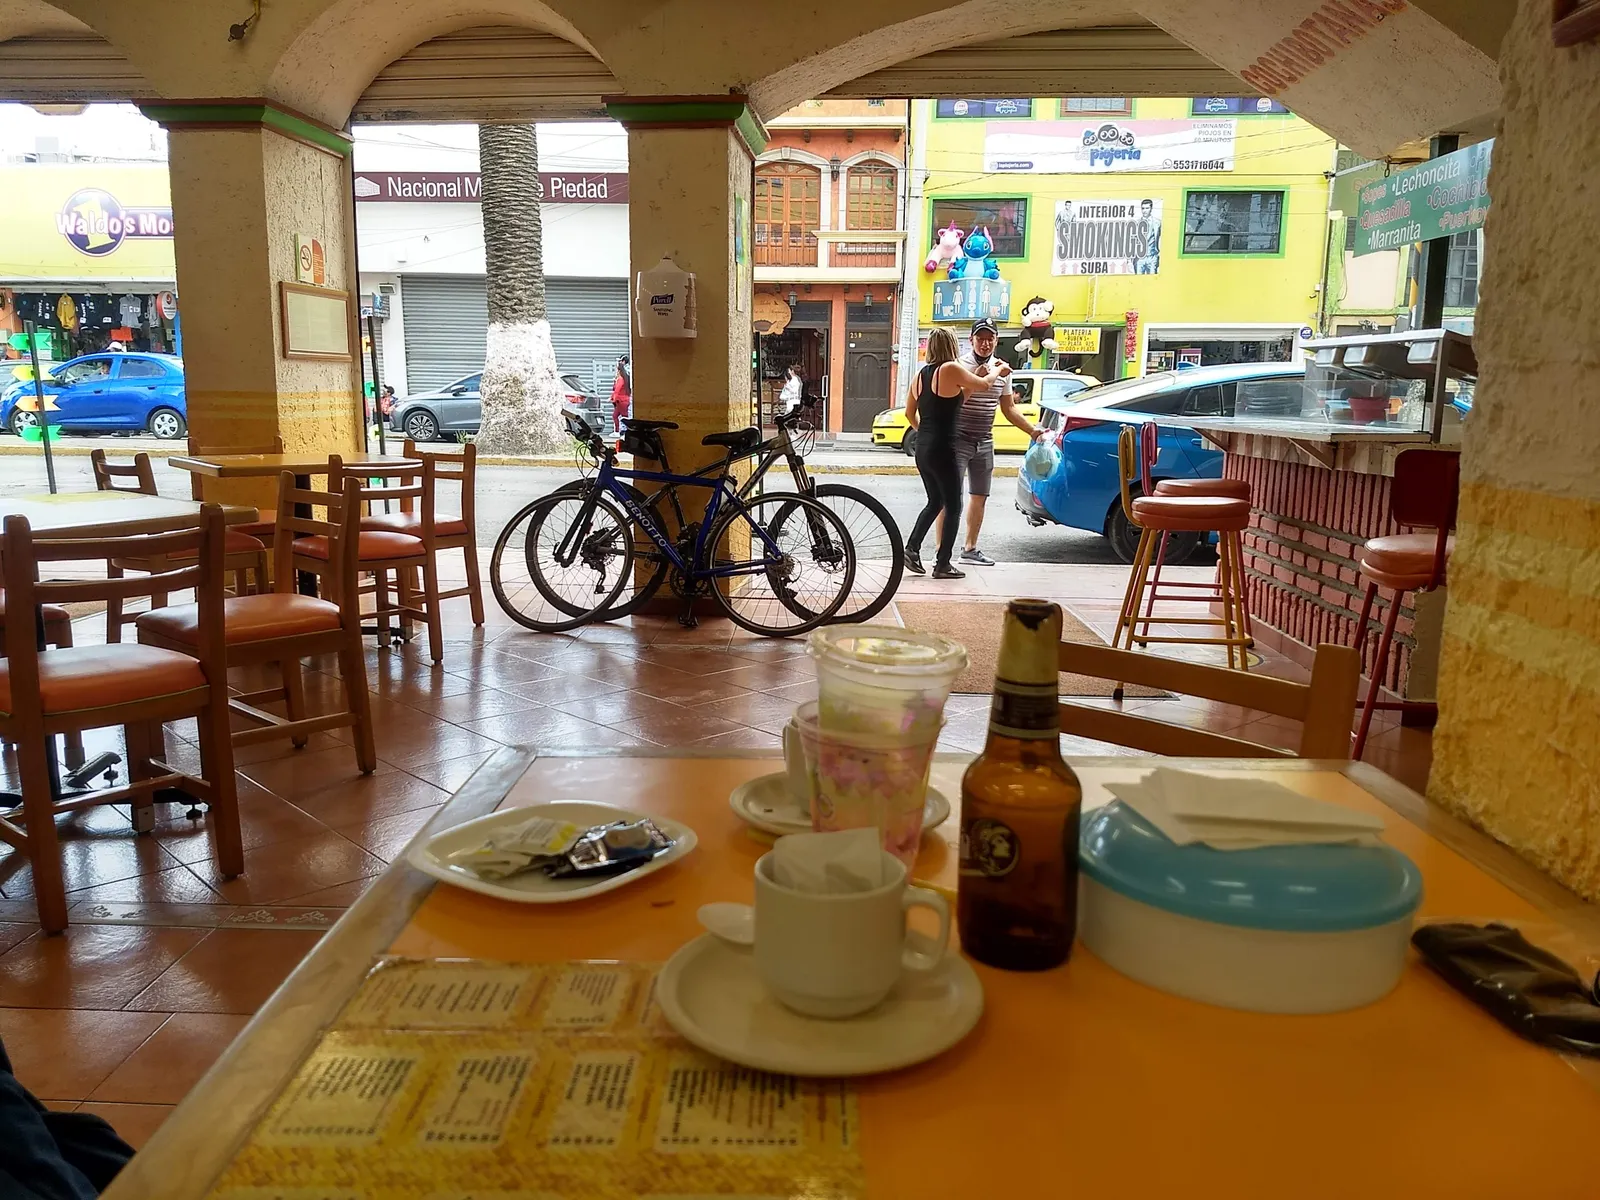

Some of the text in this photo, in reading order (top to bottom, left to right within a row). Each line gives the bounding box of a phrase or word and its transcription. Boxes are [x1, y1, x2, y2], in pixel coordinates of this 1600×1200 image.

[1173, 159, 1225, 170] 5531716044
[1396, 157, 1461, 196] Lechoncita
[387, 177, 462, 198] Nacional
[551, 177, 608, 198] Piedad
[55, 210, 135, 236] Waldo's
[1079, 205, 1135, 218] INTERIOR 4
[1362, 197, 1411, 231] Quesadilla
[1058, 220, 1149, 260] SMOKINGS
[1370, 220, 1421, 250] Marranita
[1080, 261, 1109, 274] SUBA
[625, 499, 667, 547] BENOTTO
